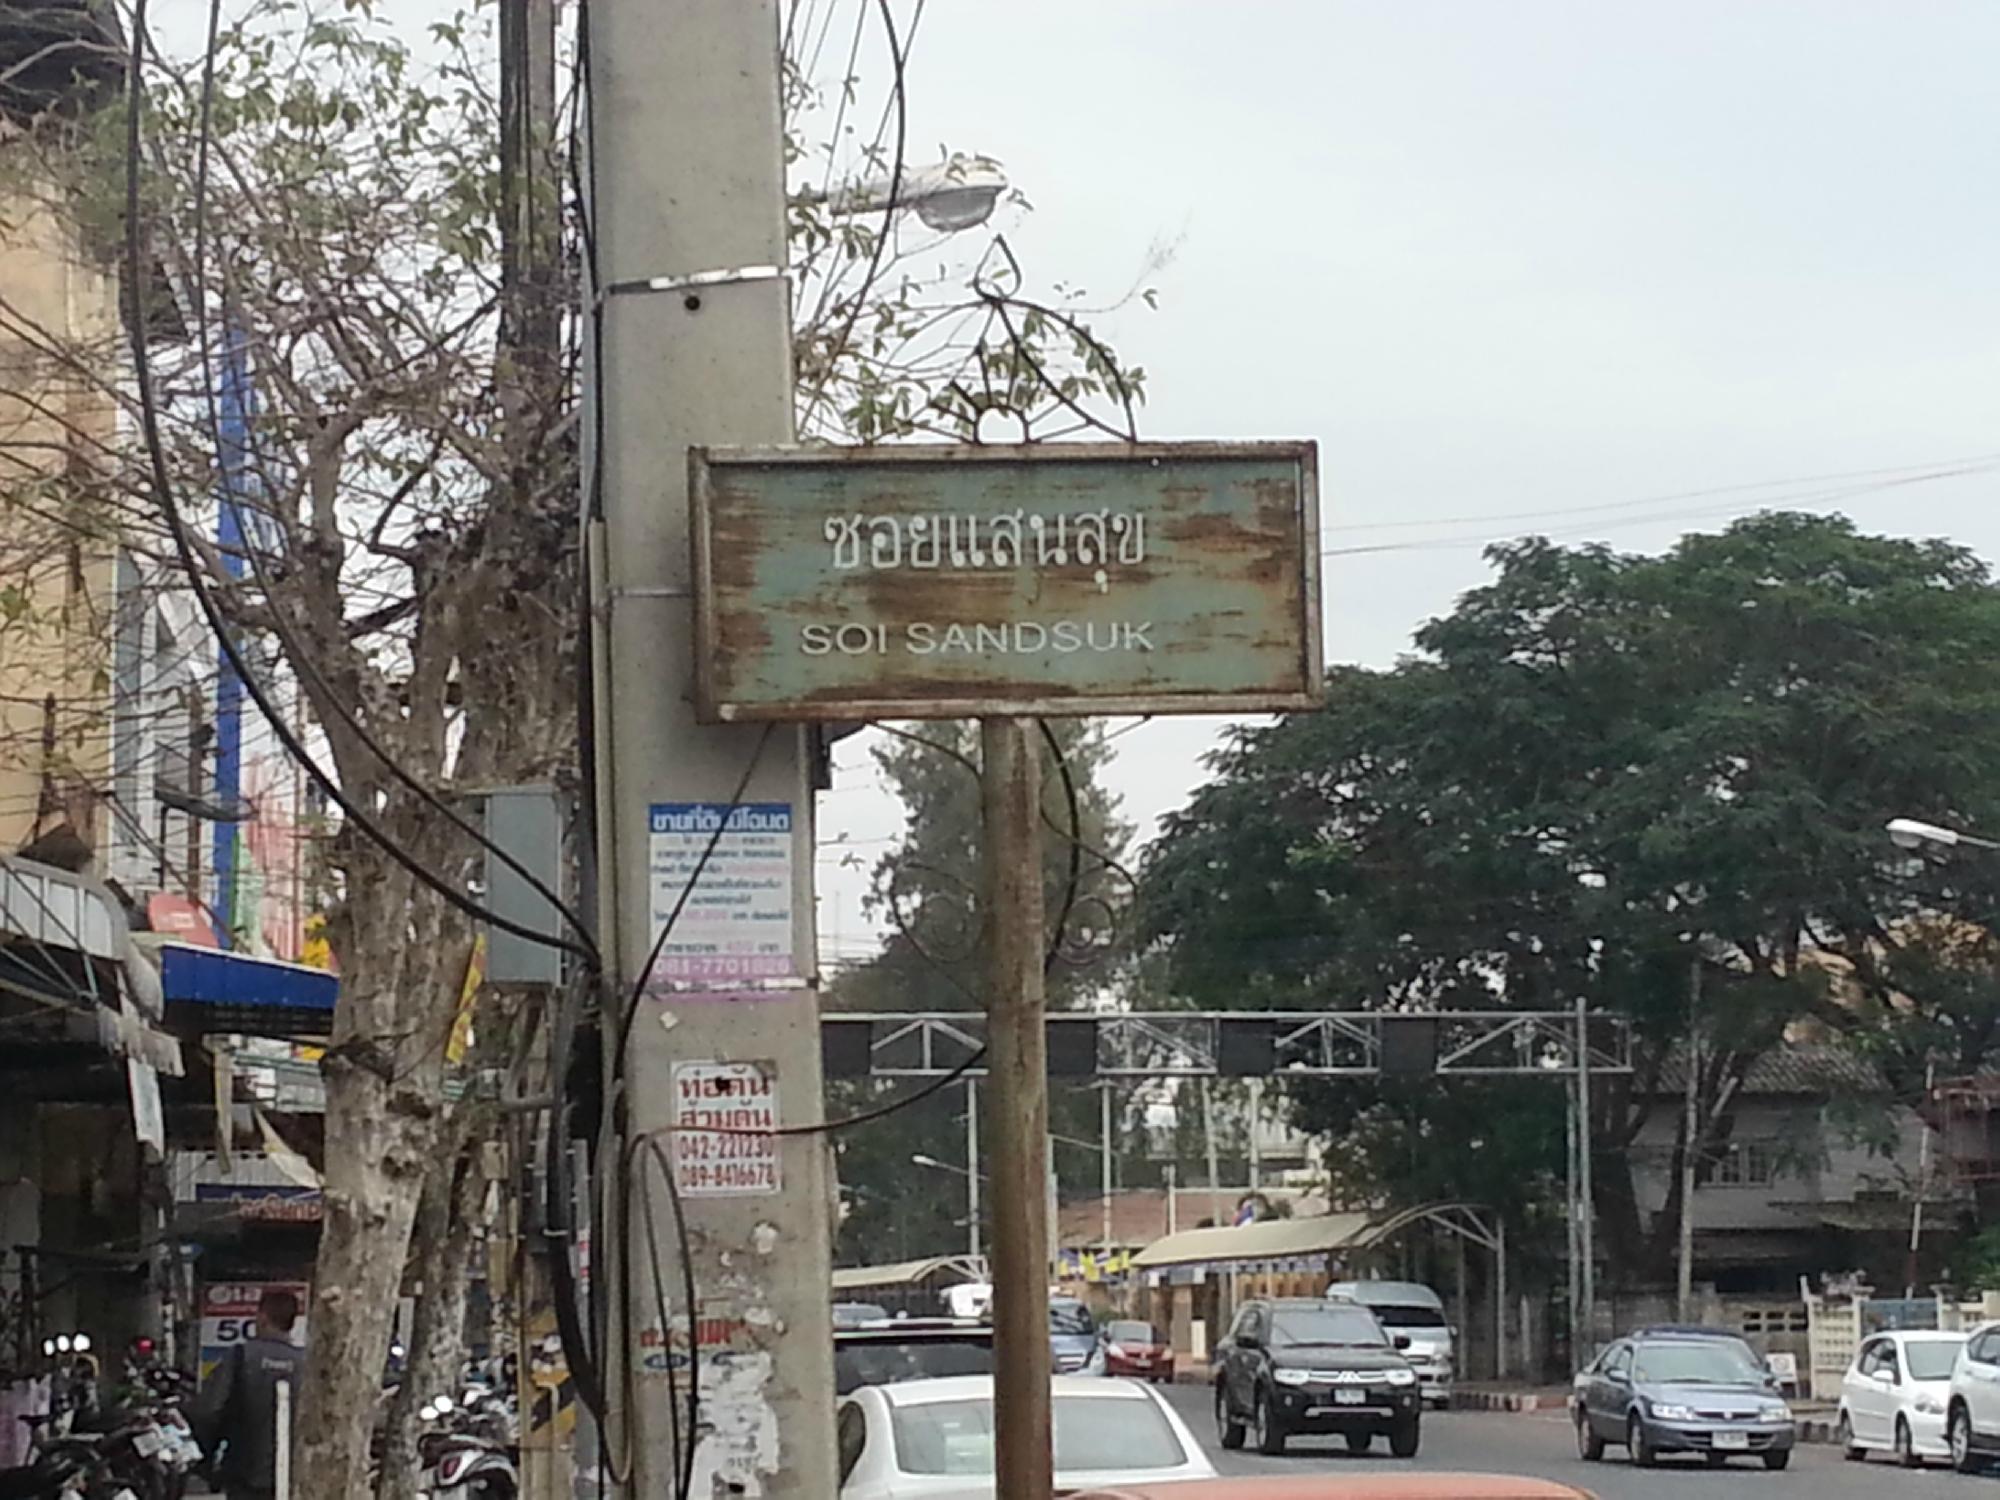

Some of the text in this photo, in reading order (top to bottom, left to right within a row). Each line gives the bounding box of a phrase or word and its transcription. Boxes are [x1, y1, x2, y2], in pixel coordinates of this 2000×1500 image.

[824, 507, 1147, 593] ซอยแสนสุข
[801, 620, 1154, 656] SOI SANDSUK
